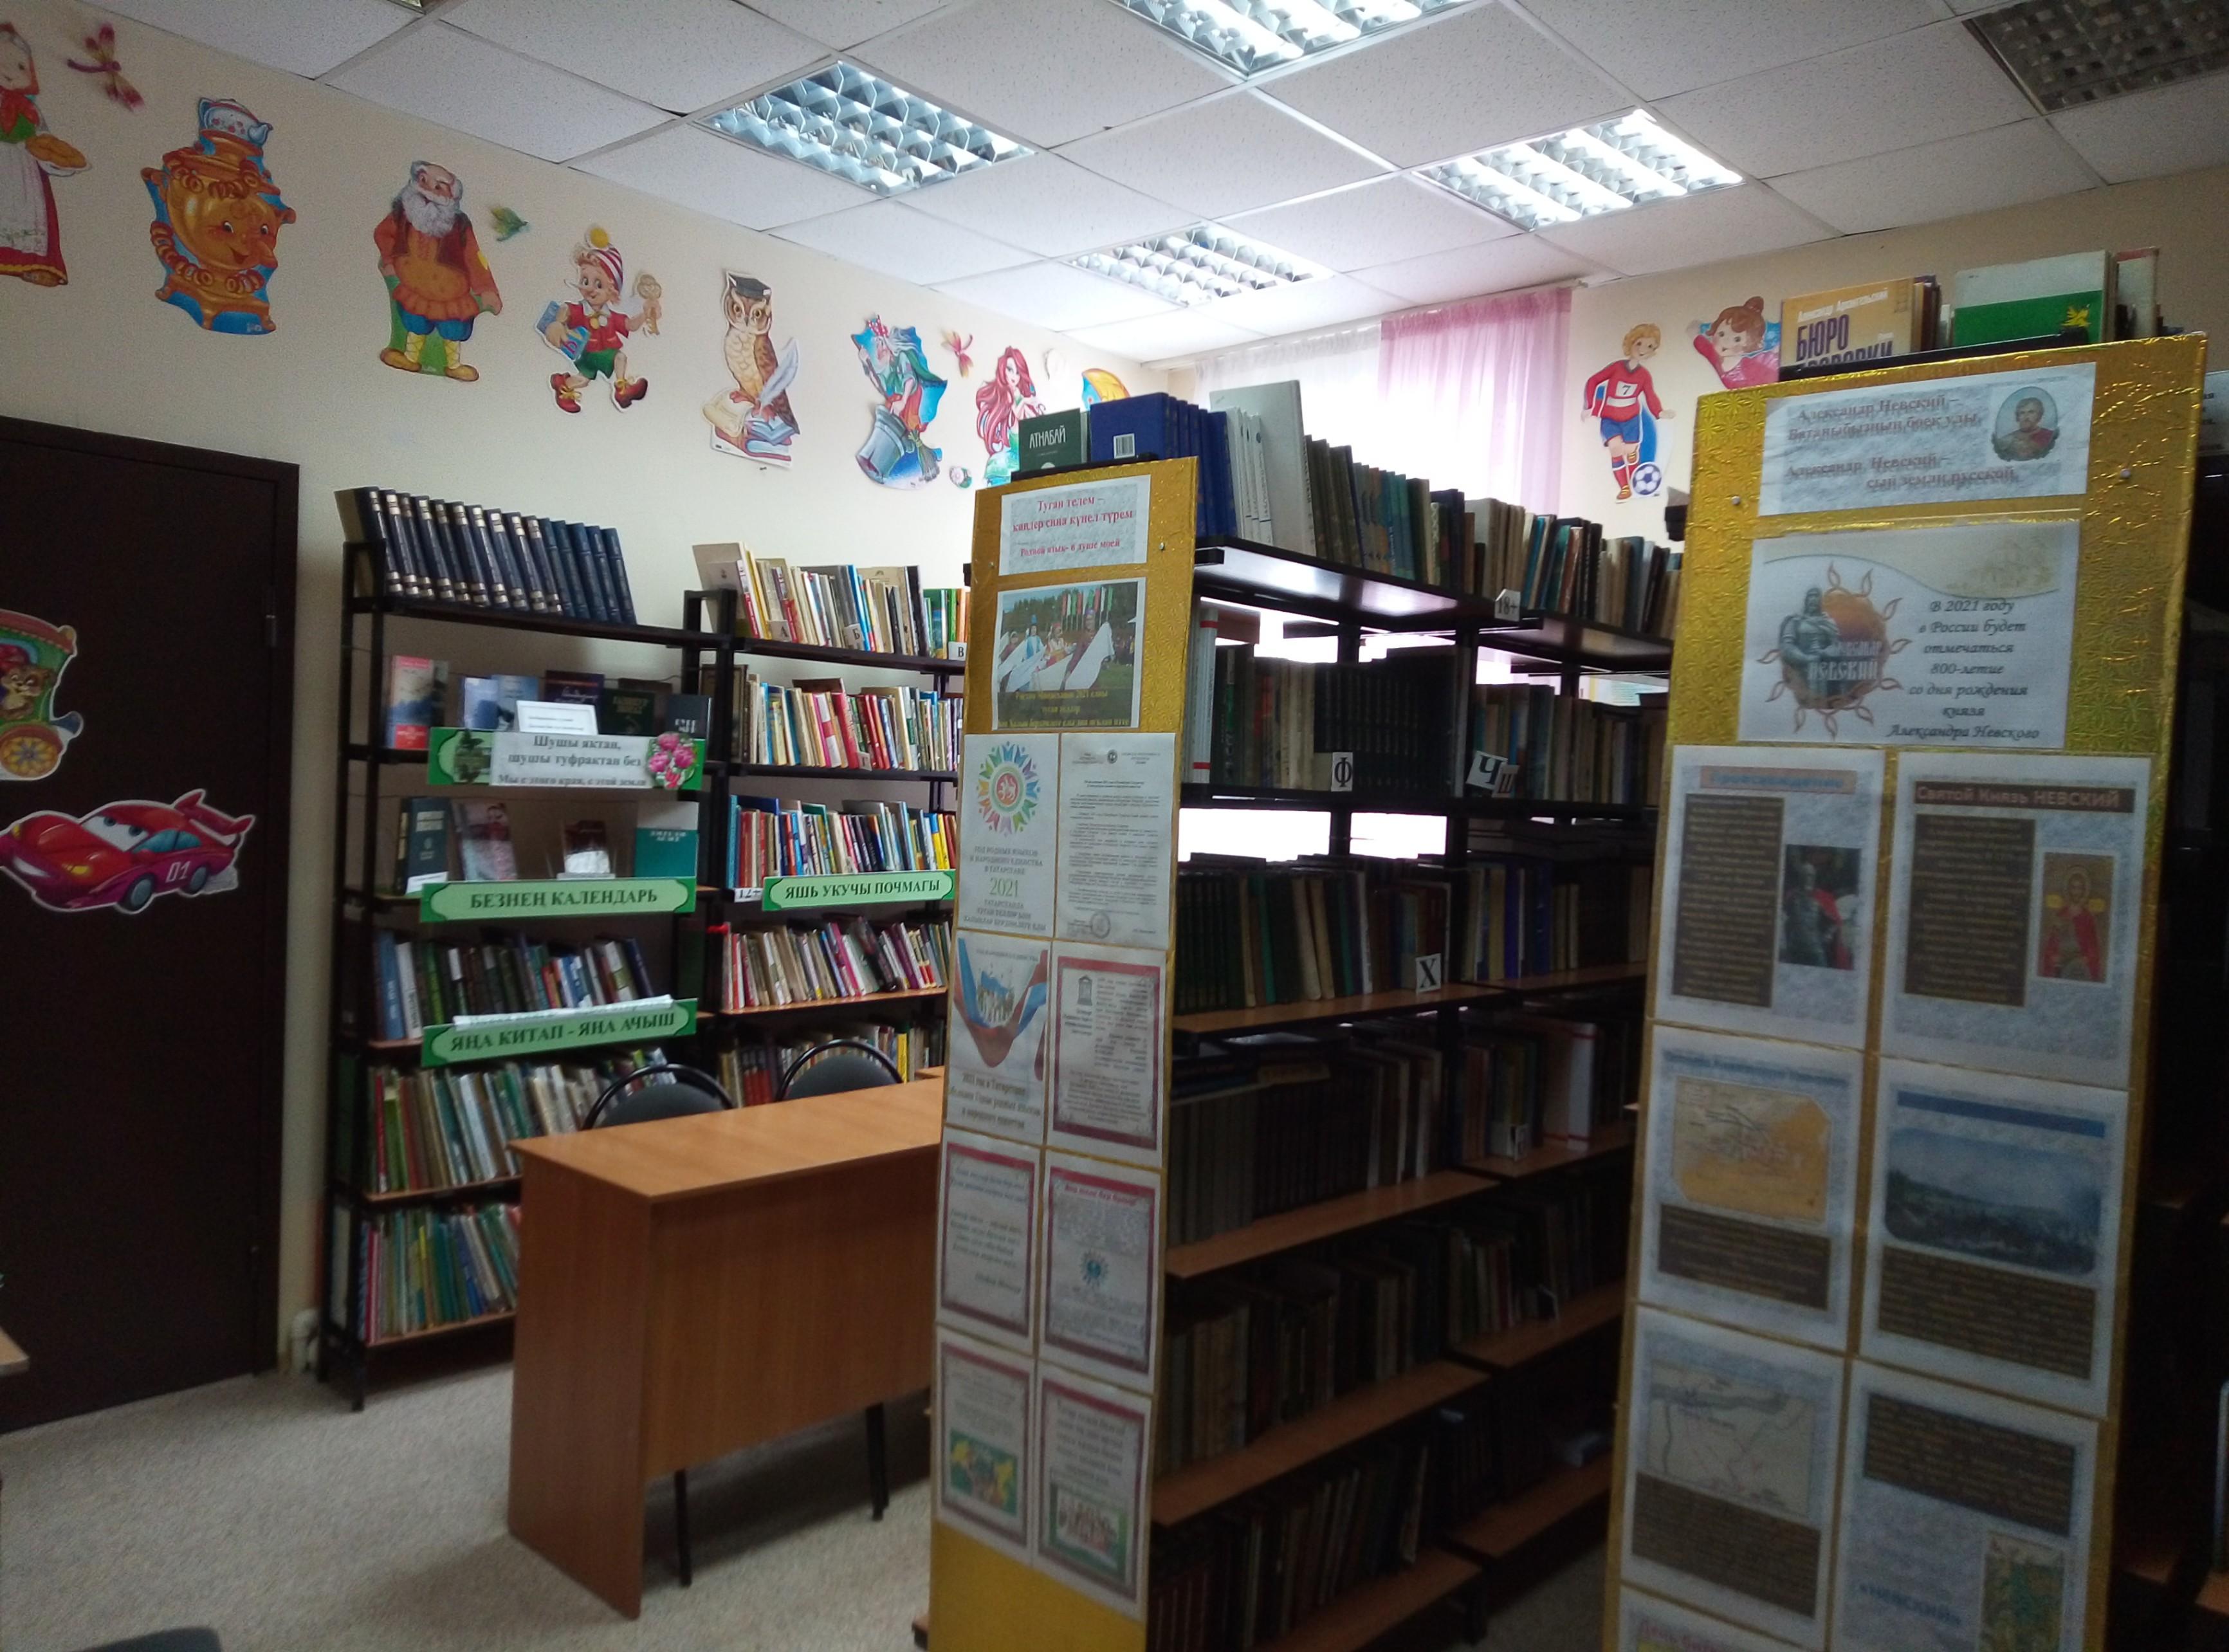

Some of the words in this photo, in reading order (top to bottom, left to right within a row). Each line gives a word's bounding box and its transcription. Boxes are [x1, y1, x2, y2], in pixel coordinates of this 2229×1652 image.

[1797, 314, 1849, 362] БЮРО
[1622, 385, 1631, 395] 7
[1797, 403, 1873, 423] Александр
[1879, 394, 1945, 414] Невский
[1030, 425, 1066, 449] АТНАБАЙ
[1787, 460, 1862, 477] Александр
[1871, 452, 1937, 470] Невский
[1867, 476, 1896, 490] сын
[1038, 500, 1063, 513] Туган
[1067, 497, 1095, 508] телем
[1498, 596, 1517, 614] 18+
[1930, 600, 1940, 612] В
[1946, 600, 1979, 612] 2021
[1983, 600, 2015, 616] году
[780, 627, 788, 638] А
[854, 629, 860, 640] Б
[1931, 620, 1979, 633] России
[1983, 618, 2026, 637] будет
[957, 647, 964, 657] В
[1924, 643, 2014, 655] отмечаться
[1931, 661, 2004, 675] 800-летие
[1927, 683, 1951, 696] дня
[1956, 684, 2028, 700] рождения
[1943, 707, 1985, 719] князя
[1886, 724, 1970, 740] Александра
[1973, 724, 2039, 739] Невского
[534, 735, 580, 749] Шушы
[508, 754, 551, 766] шушы
[556, 754, 620, 767] туфрактан
[1335, 757, 1352, 787] Ф
[1479, 757, 1503, 784] Ч
[1916, 785, 1974, 801] Святой
[2033, 789, 2120, 809] НЕВСКИЙ
[165, 860, 191, 883] 01
[785, 886, 818, 900] ЯШЬ
[823, 883, 870, 898] УКУЧЫ
[876, 879, 940, 895] ПОЧМАГЫ
[989, 877, 1019, 897] 2021
[471, 892, 546, 909] БЕЗНЕҢ
[553, 888, 657, 906] КАЛЕНДАРЬ
[1419, 958, 1437, 989] Х
[450, 1034, 493, 1052] ЯҢА
[499, 1028, 564, 1046] КИТАП
[578, 1020, 616, 1037] ЯҢА
[622, 1013, 675, 1031] АЧЫШ
